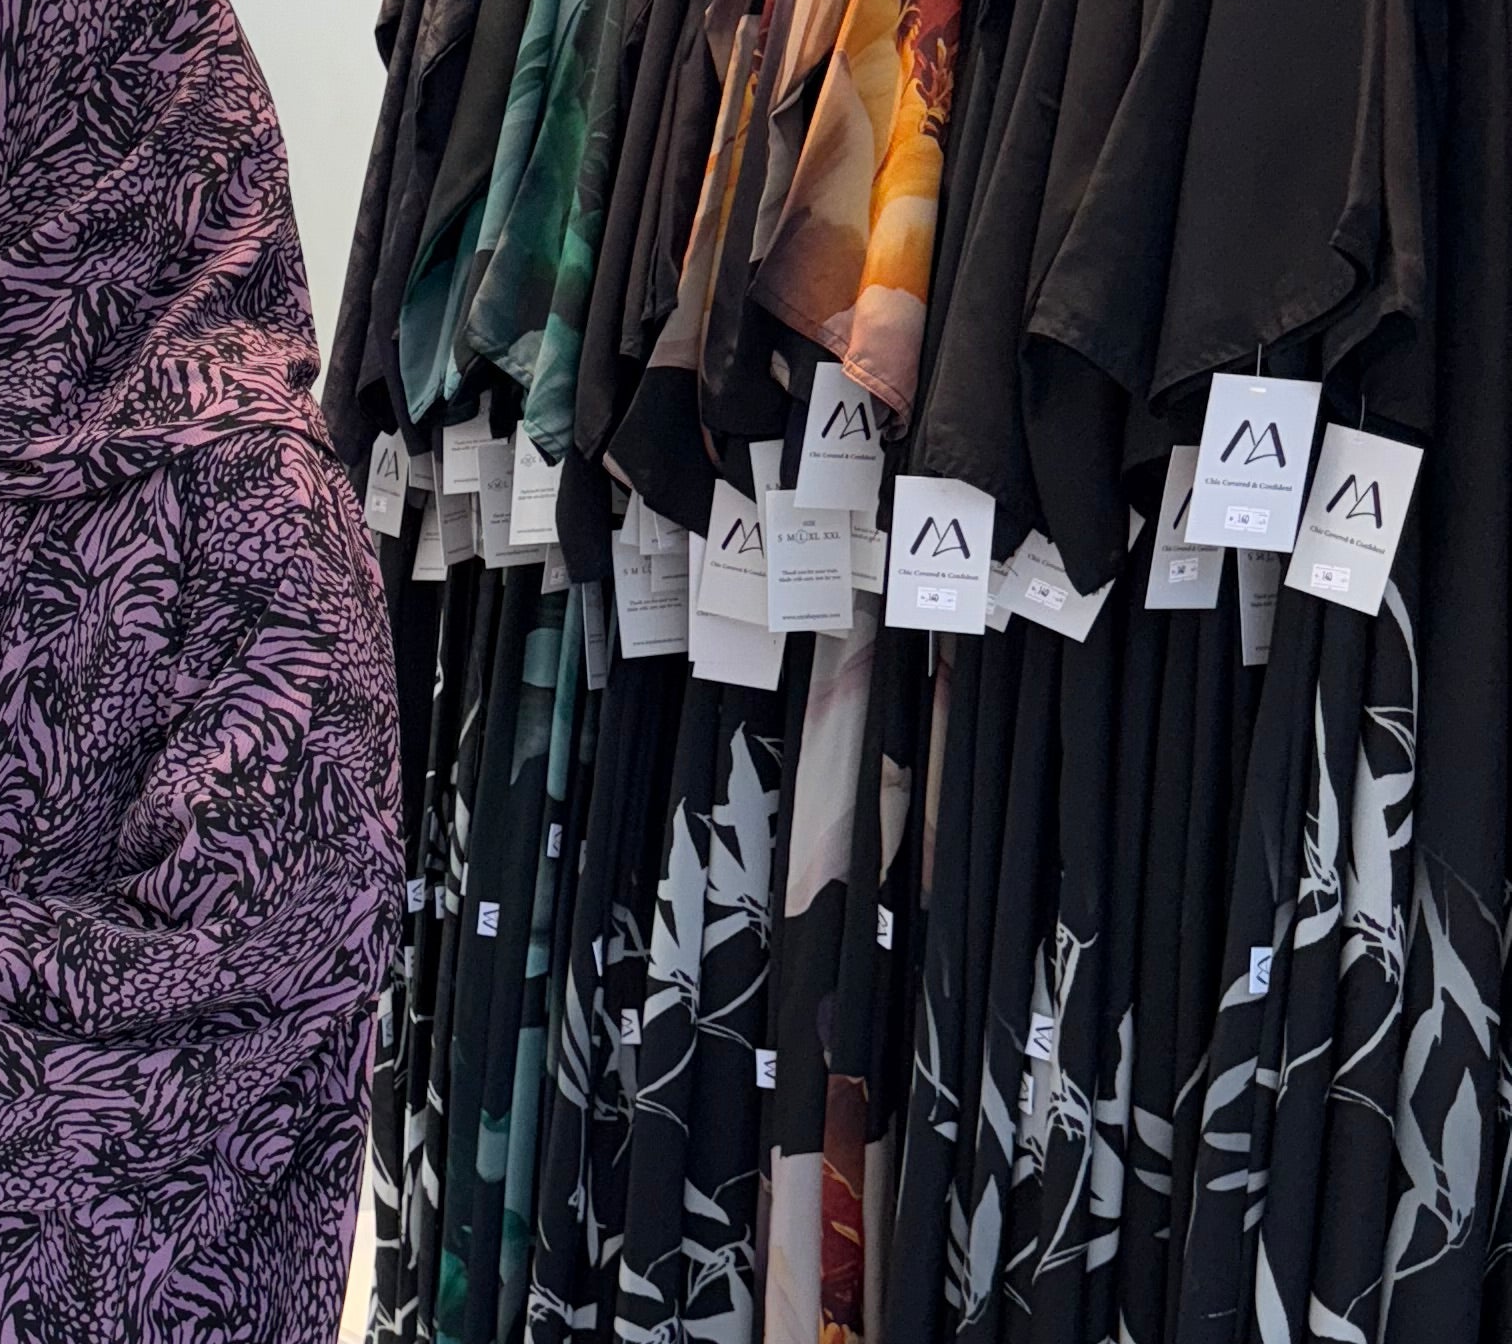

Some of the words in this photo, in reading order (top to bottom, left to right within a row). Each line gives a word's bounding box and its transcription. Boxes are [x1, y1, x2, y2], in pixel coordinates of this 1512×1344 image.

[1205, 477, 1221, 485] Chic
[1222, 479, 1250, 488] Covered
[1259, 482, 1293, 492] Confident
[777, 533, 783, 543] S
[1309, 525, 1323, 535] Chic
[1324, 529, 1349, 543] Covered
[1356, 540, 1386, 555] Confident
[898, 568, 913, 576] Chic
[914, 569, 940, 578] Covered
[948, 572, 979, 580] Confident
